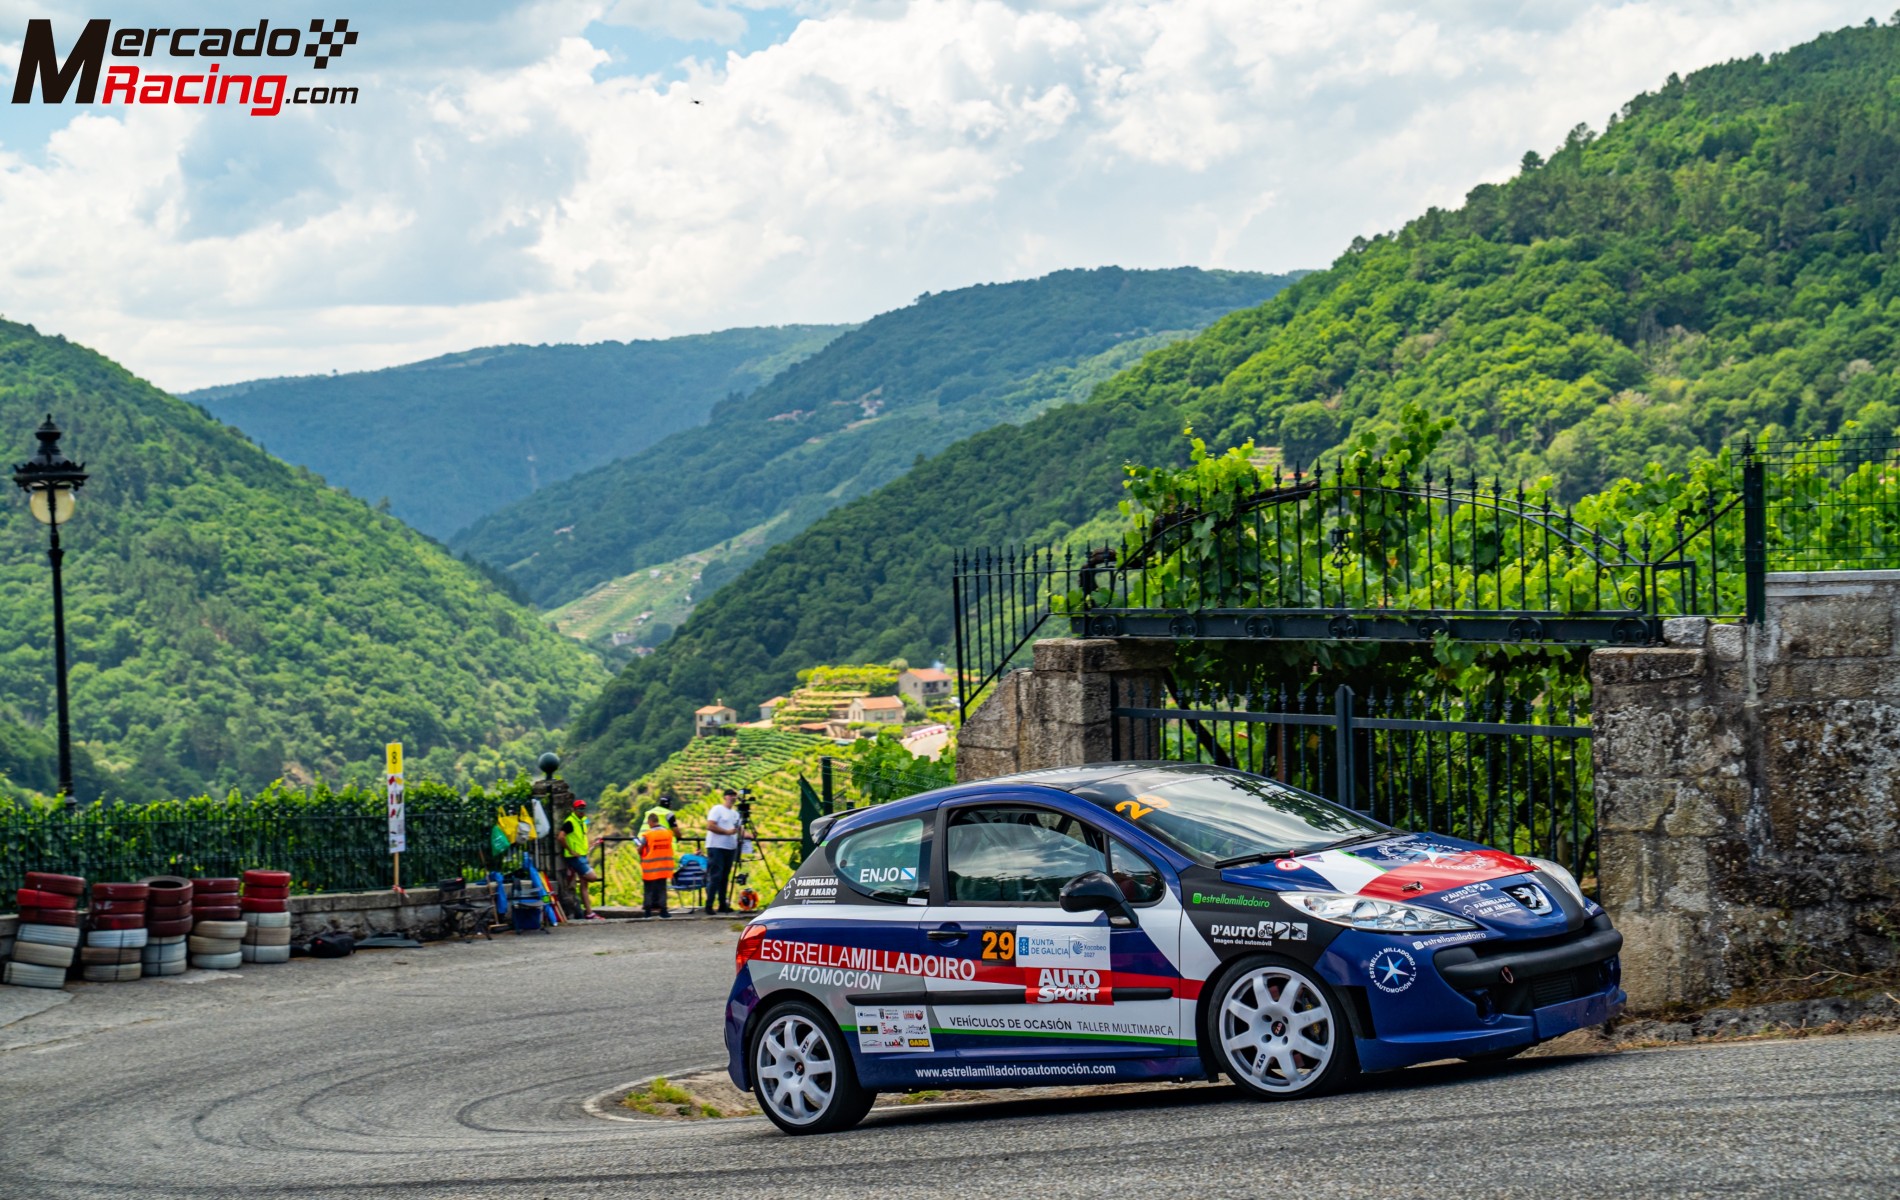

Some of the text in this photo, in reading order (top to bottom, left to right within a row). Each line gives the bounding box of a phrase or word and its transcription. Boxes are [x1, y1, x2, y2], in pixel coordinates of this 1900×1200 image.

[391, 751, 398, 765] 8
[797, 878, 839, 887] PARRILLADA
[859, 867, 899, 883] ENJO
[794, 888, 838, 897] SAN AMARO
[1201, 893, 1270, 908] estrellamilladoiro
[1210, 924, 1256, 938] D'AUTO
[982, 931, 1015, 960] 29
[1031, 938, 1055, 947] XUNTA
[1423, 931, 1487, 947] estrellamilladoiro
[1030, 947, 1069, 956] DE GALICIA
[760, 938, 976, 981] ESTRELLAMILLADOIRO
[1368, 947, 1416, 979] ESTRELLA MILLADOIRO
[778, 963, 882, 991] AUTOMOCIÓN
[1038, 968, 1100, 989] AUTO
[949, 1015, 1174, 1036] VEHÍCULOS DE OCASIÓN TALLER MULTIMARCA
[915, 1064, 1116, 1078] www.estrellamilladoiroautomoción.com
